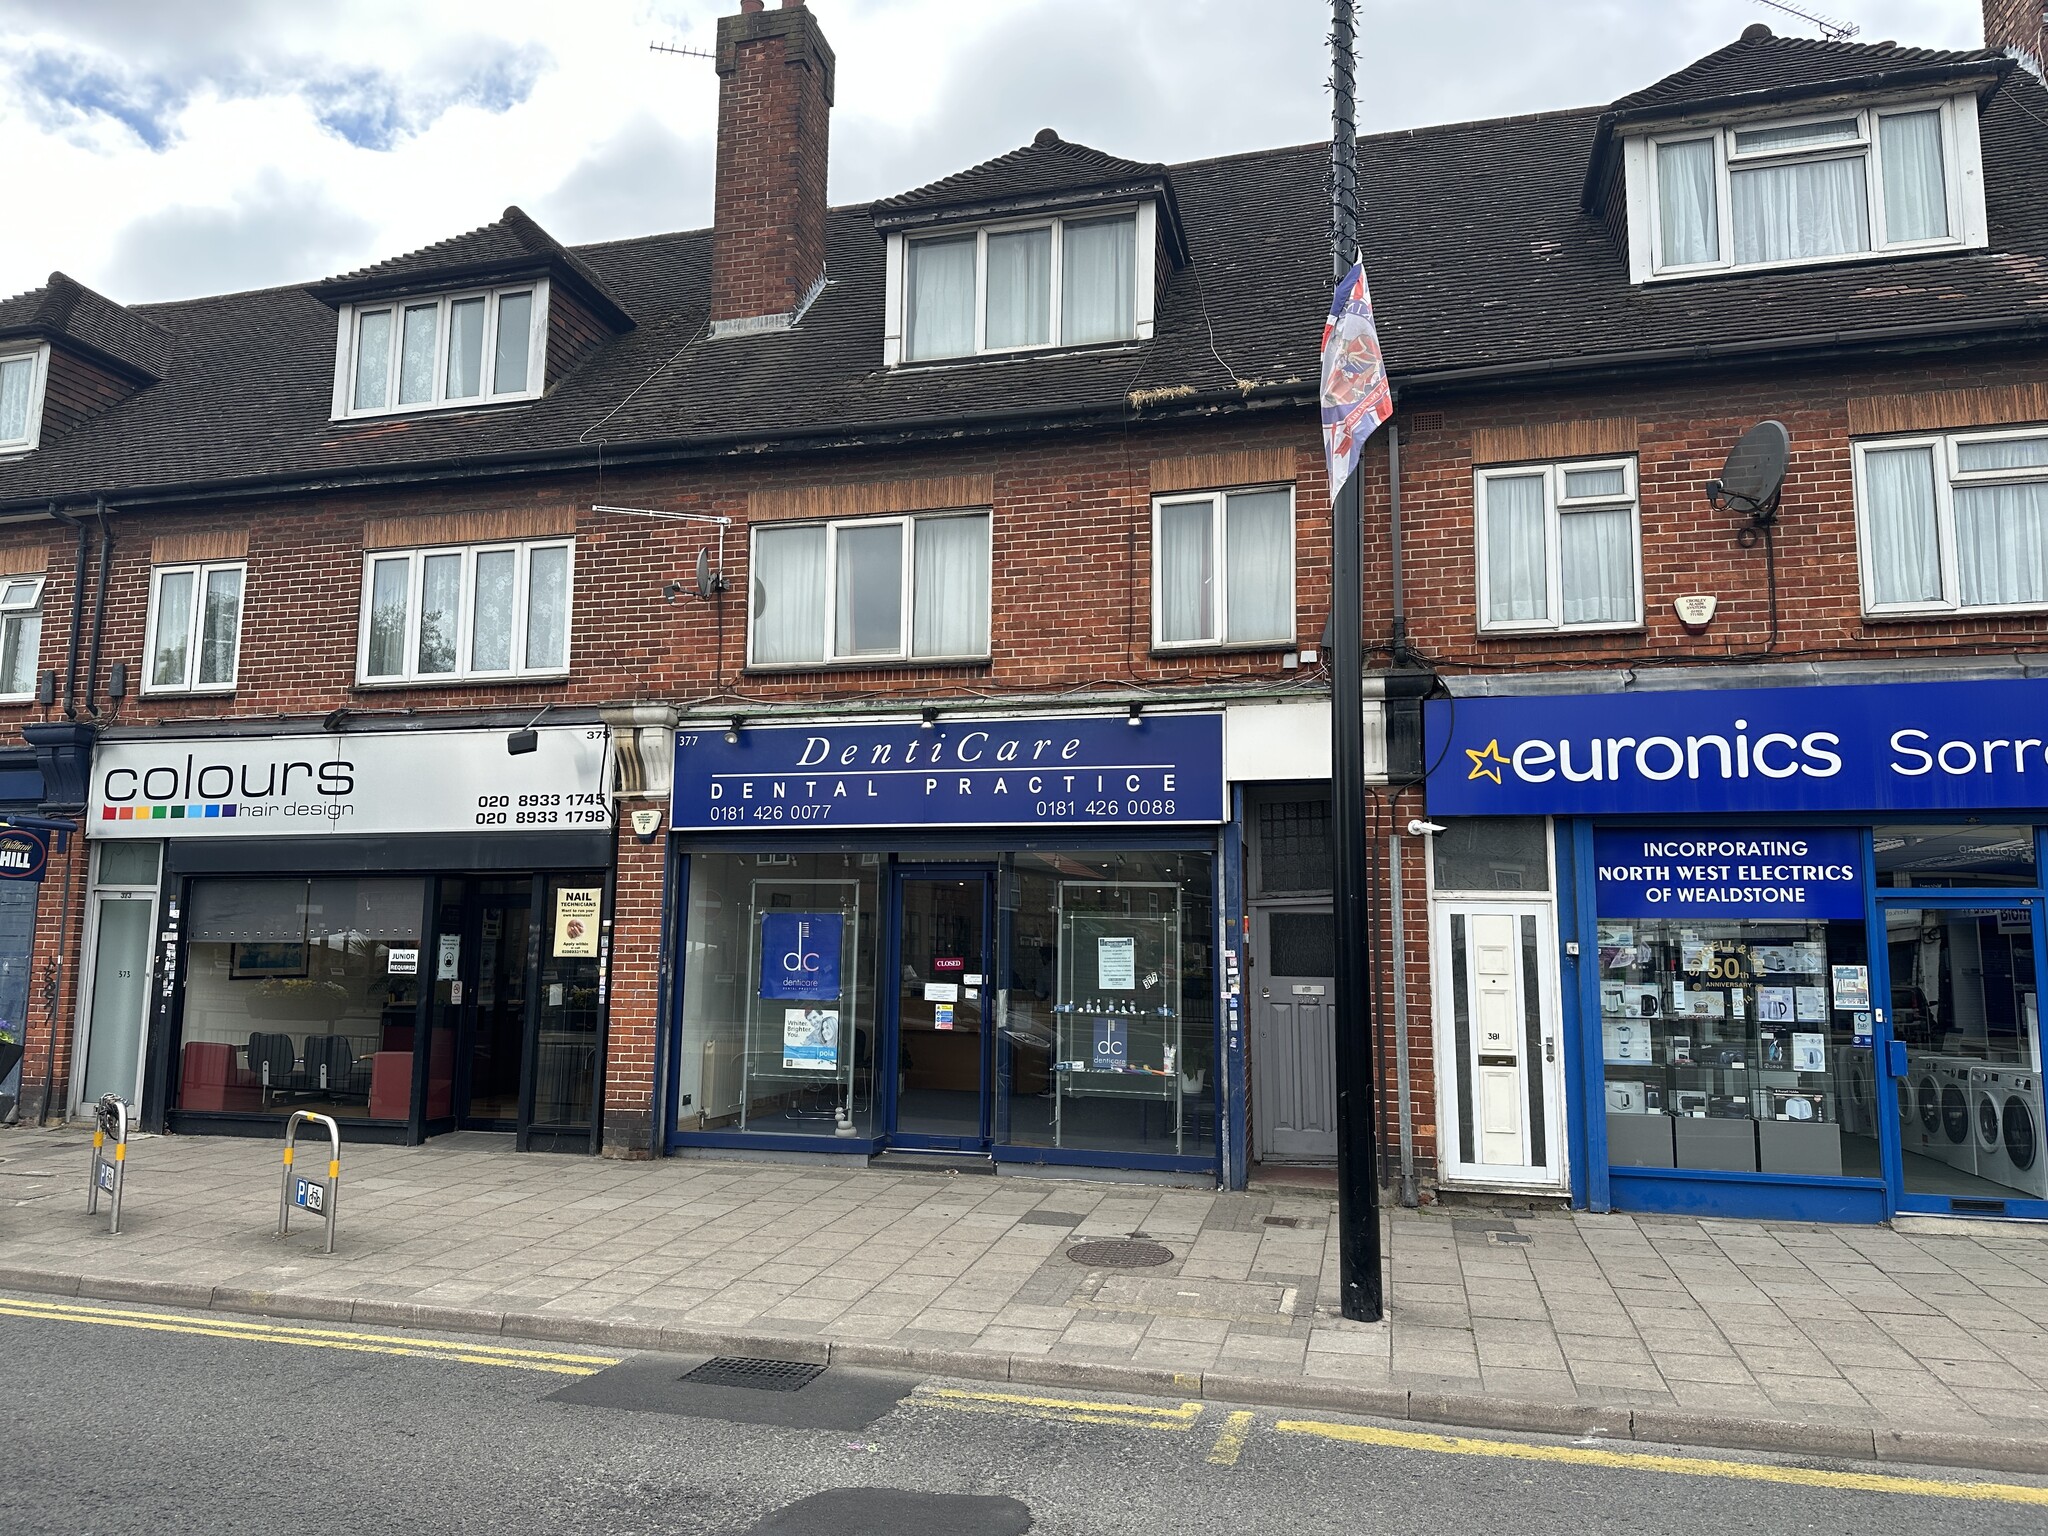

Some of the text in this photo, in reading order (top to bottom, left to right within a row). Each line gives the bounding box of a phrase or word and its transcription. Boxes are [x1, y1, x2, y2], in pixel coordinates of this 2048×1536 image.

[586, 731, 610, 740] 375
[679, 736, 698, 746] 377
[796, 732, 1080, 766] DentiCare
[1512, 719, 2048, 783] euronics Sorr
[104, 754, 354, 801] colours
[711, 774, 1176, 799] DENTAL PRACTICE
[478, 794, 606, 808] 020 8933 1745
[1036, 800, 1176, 816] 0181 426 0088
[239, 802, 354, 820] hair design
[476, 810, 605, 824] 020 8933 1798
[710, 804, 832, 820] 0181 426 0077
[0, 838, 33, 850] William
[1644, 842, 1808, 857] INCORPORATING
[0, 851, 30, 868] HILL
[1598, 865, 1854, 880] NORTH WEST ELECTRICS
[566, 892, 592, 901] NAIL
[1646, 888, 1805, 902] OF WEALDSTONE
[784, 922, 820, 972] dc
[1738, 944, 1746, 954] &
[782, 977, 818, 986] denticare
[1098, 1020, 1122, 1054] dc
[1094, 1056, 1126, 1064] denticare
[298, 1182, 305, 1202] P
